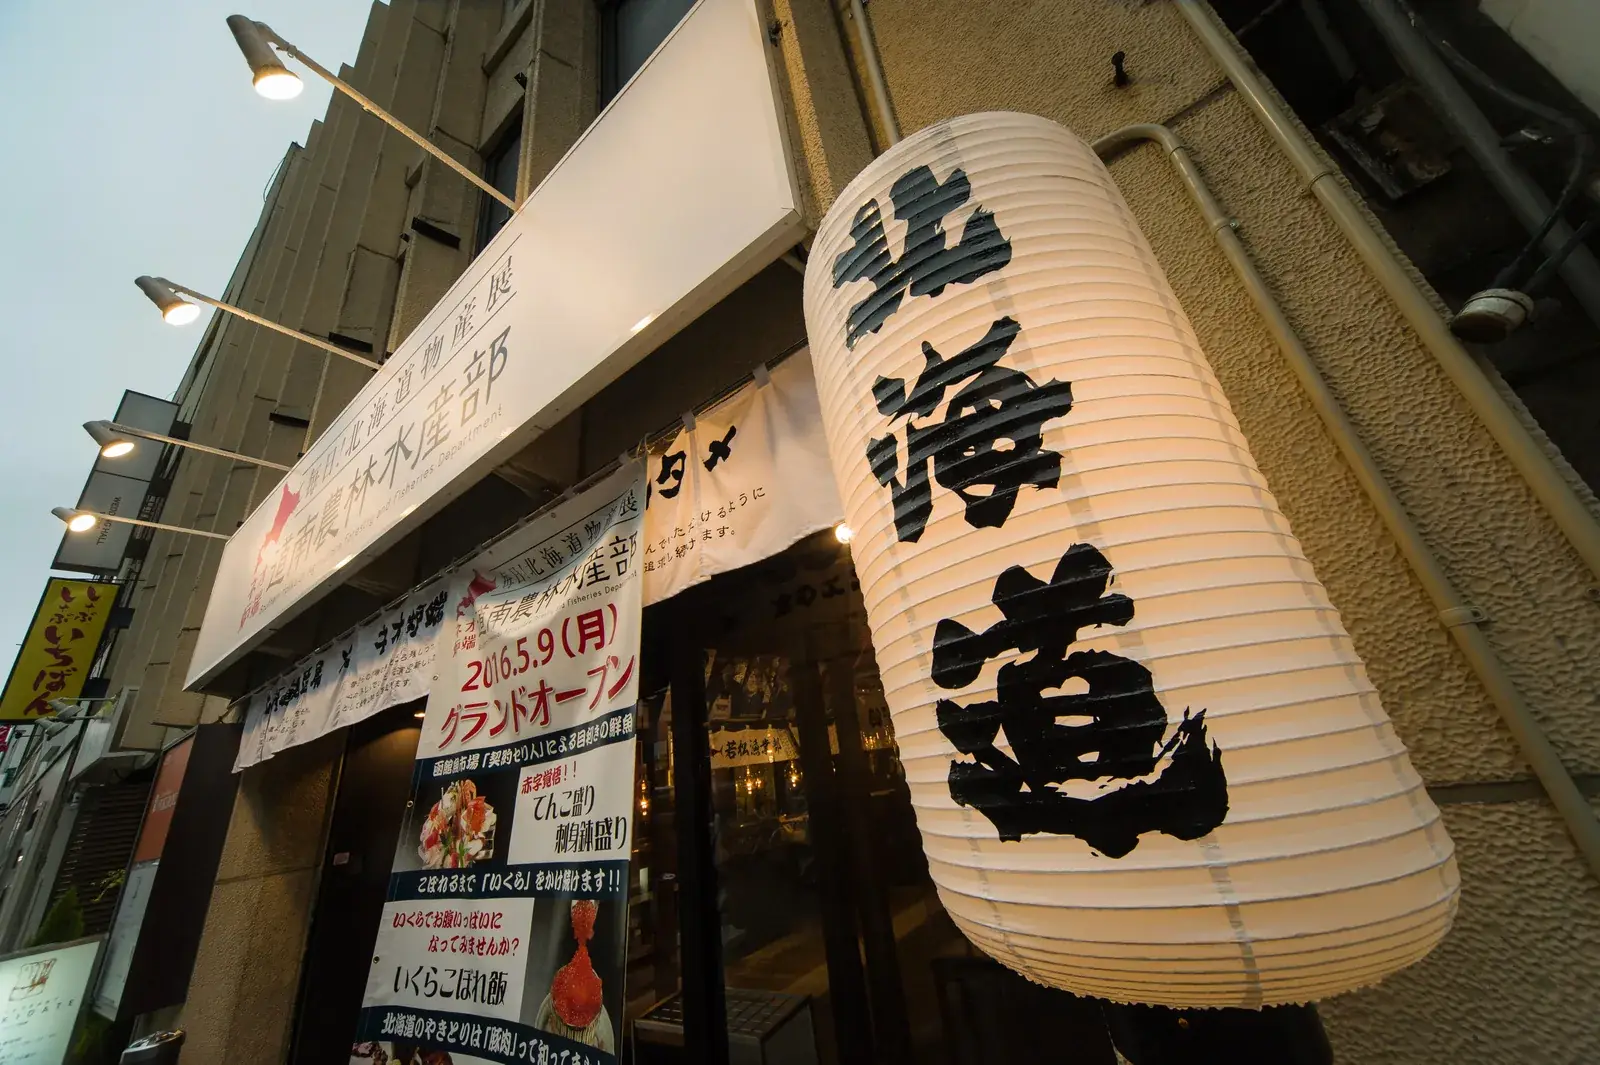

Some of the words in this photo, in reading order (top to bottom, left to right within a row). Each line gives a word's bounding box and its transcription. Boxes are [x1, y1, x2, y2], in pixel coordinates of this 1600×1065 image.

[266, 325, 511, 592] 道南農林水産部
[394, 464, 434, 505] Fisheries
[438, 403, 503, 467] Department
[833, 165, 1229, 859] 北海道
[475, 530, 638, 637] 道南農林水産部
[567, 589, 602, 609] Fisheries
[23, 625, 86, 716] いちばん
[437, 654, 636, 749] グランドオープン
[533, 785, 595, 821] てんこ盛り
[554, 816, 627, 854] 刺身鉢盛り
[392, 909, 503, 930] いくらでお腹いっぱいに
[393, 965, 509, 1006] いくらこぼれ飯
